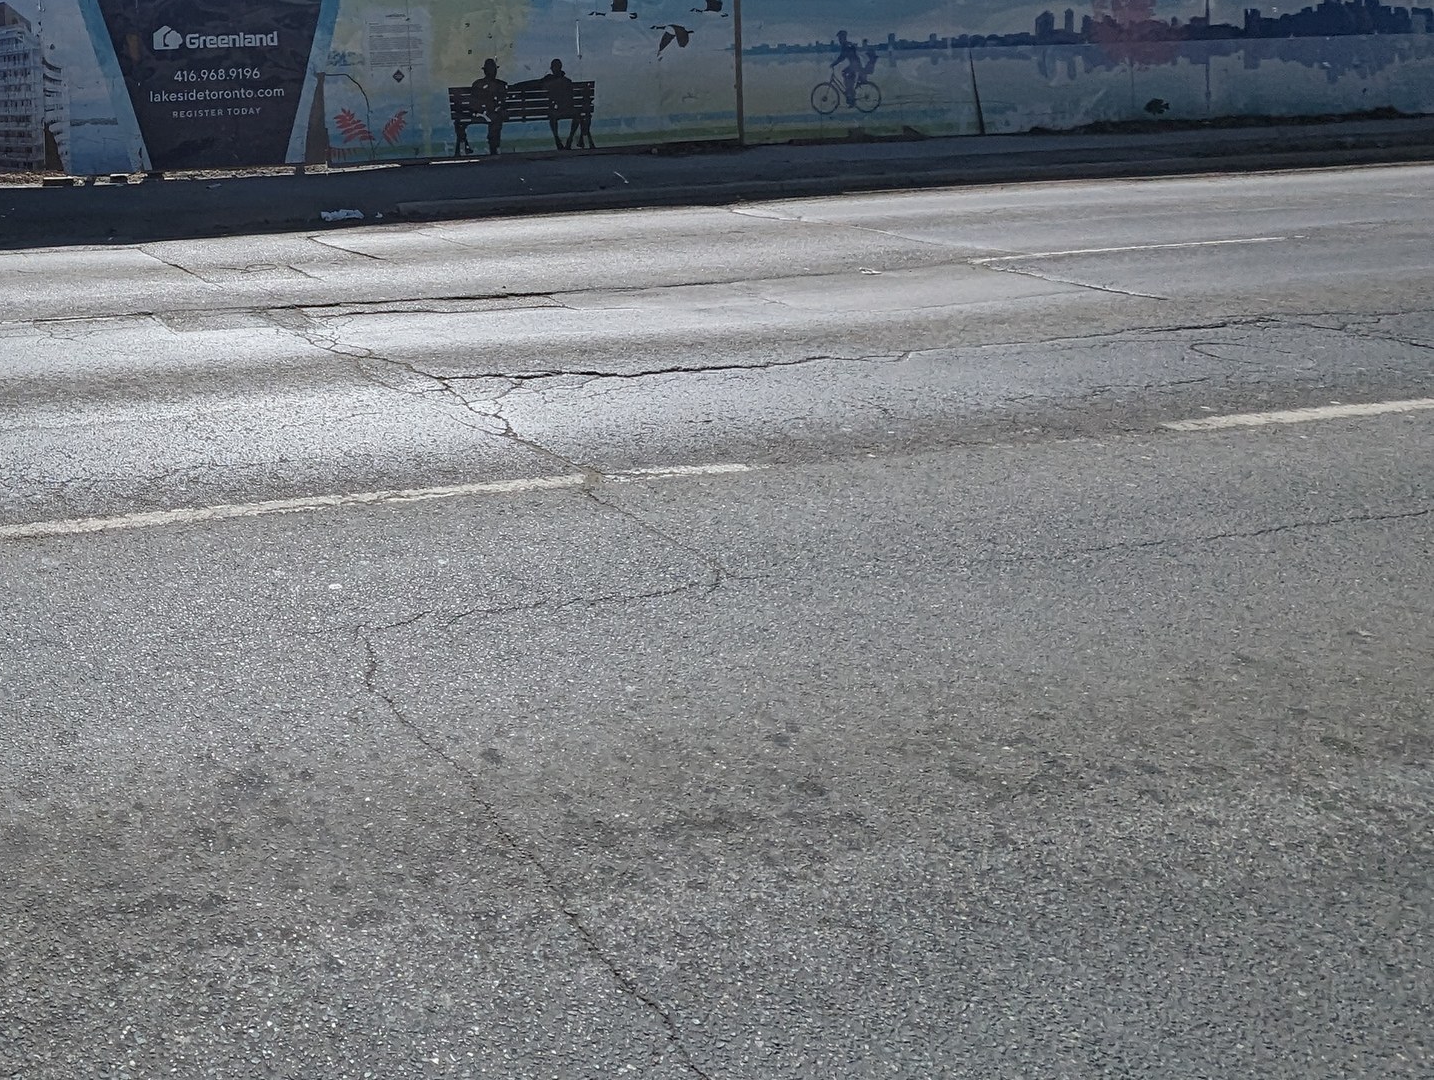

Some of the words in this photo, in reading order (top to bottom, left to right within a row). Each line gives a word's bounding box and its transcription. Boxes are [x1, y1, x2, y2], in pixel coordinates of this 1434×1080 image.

[186, 30, 278, 49] Greenland
[173, 67, 261, 82] 416.968.9196
[149, 88, 285, 103] lakesidetoronto.com
[172, 108, 224, 119] REGISTER
[226, 107, 262, 116] TODAY
